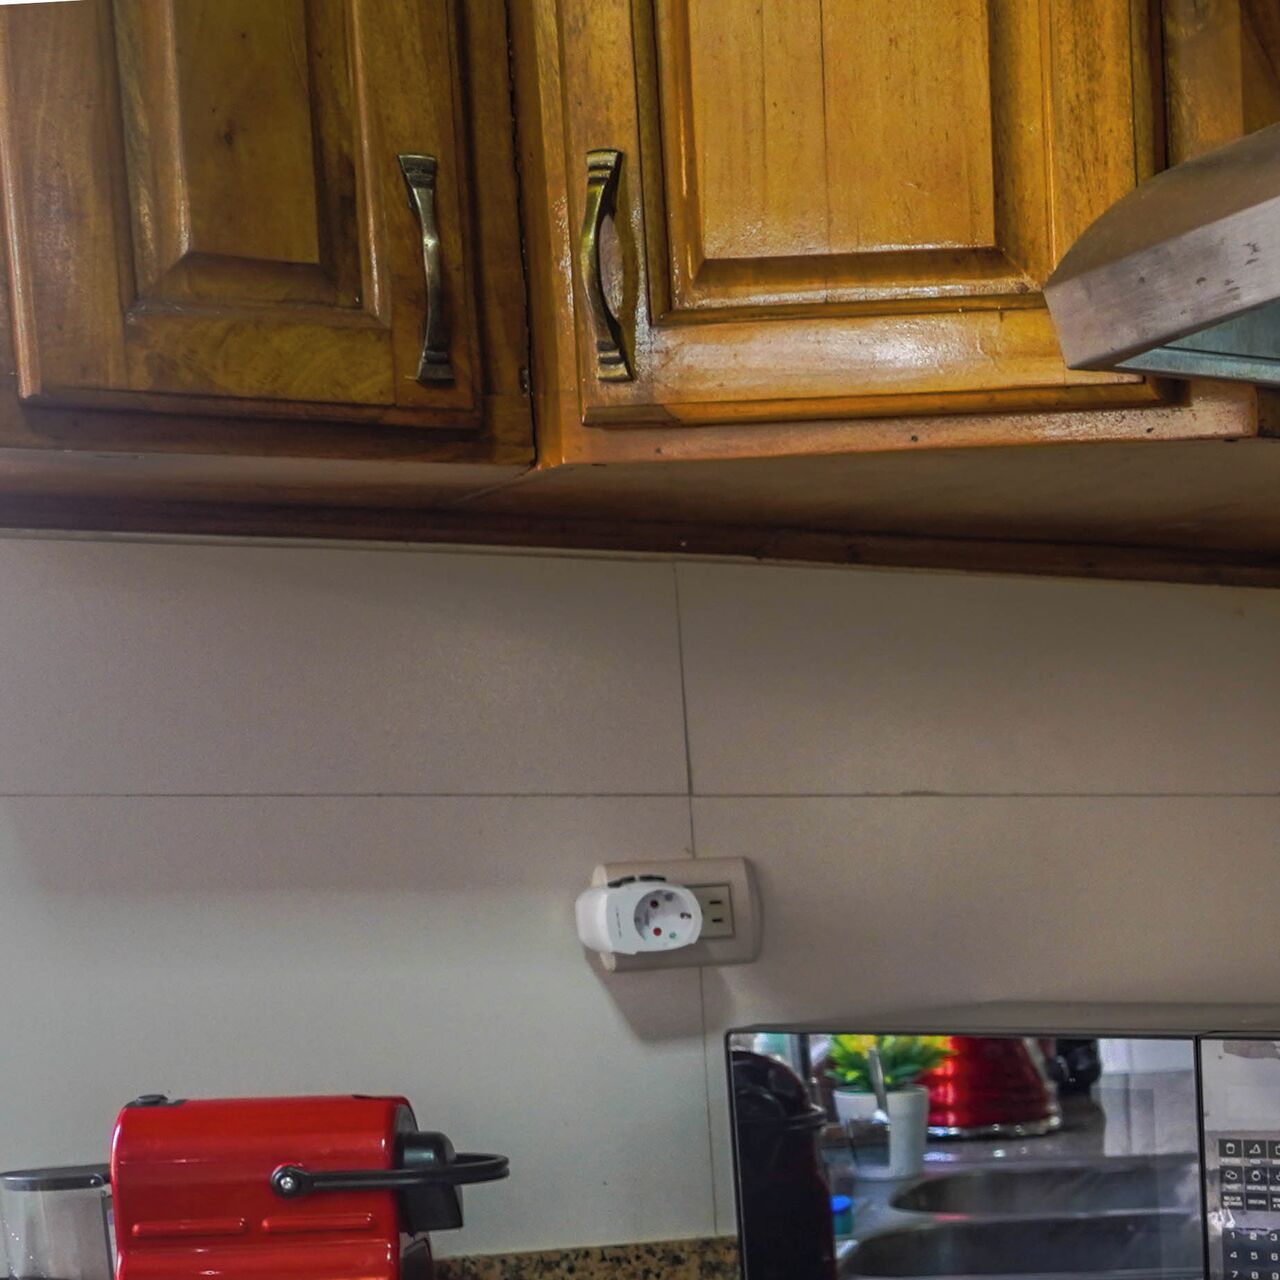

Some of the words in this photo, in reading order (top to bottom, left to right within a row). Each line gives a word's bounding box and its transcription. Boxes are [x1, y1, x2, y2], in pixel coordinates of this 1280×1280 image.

[1249, 1232, 1257, 1240] 2
[1270, 1233, 1278, 1241] 3
[1250, 1252, 1258, 1260] 5
[1271, 1253, 1278, 1261] 6
[1232, 1270, 1238, 1279] 7
[1251, 1271, 1259, 1280] 8
[1272, 1272, 1279, 1280] 9
